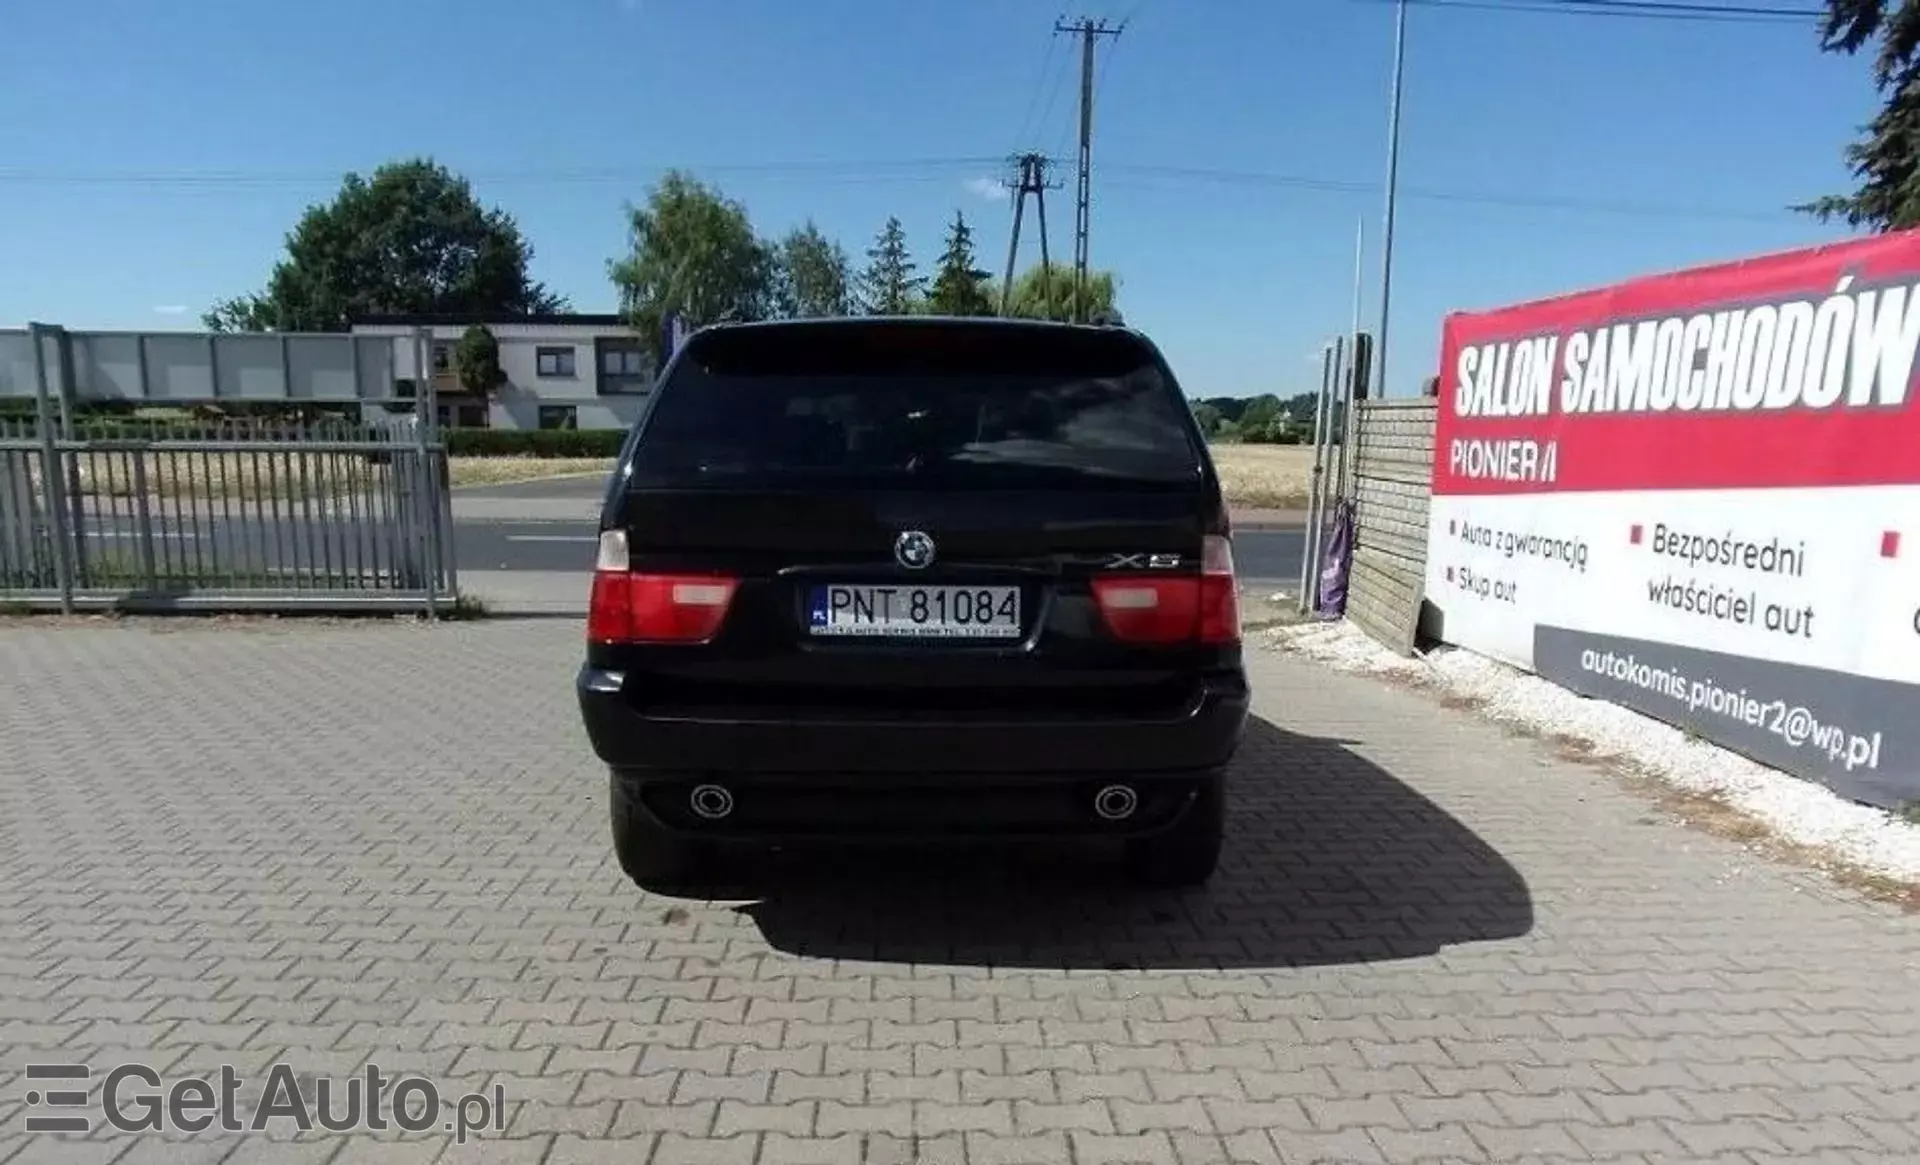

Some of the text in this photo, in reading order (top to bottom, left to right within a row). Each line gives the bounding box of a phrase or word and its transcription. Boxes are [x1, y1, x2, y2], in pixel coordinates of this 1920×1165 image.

[1456, 275, 1920, 417] SALON SAMOCHODÓW
[1450, 438, 1538, 481] PIONIER
[1105, 553, 1181, 568] X5
[1461, 520, 1492, 547] Auta
[1504, 532, 1588, 573] gwarancją
[1653, 523, 1805, 577] Bezpośredni
[831, 588, 1016, 625] PNT 81084
[1459, 566, 1517, 605] Skup aut
[1648, 577, 1816, 639] właściciel aut
[1581, 647, 1882, 771] autokomis.pionier2@wp.pl
